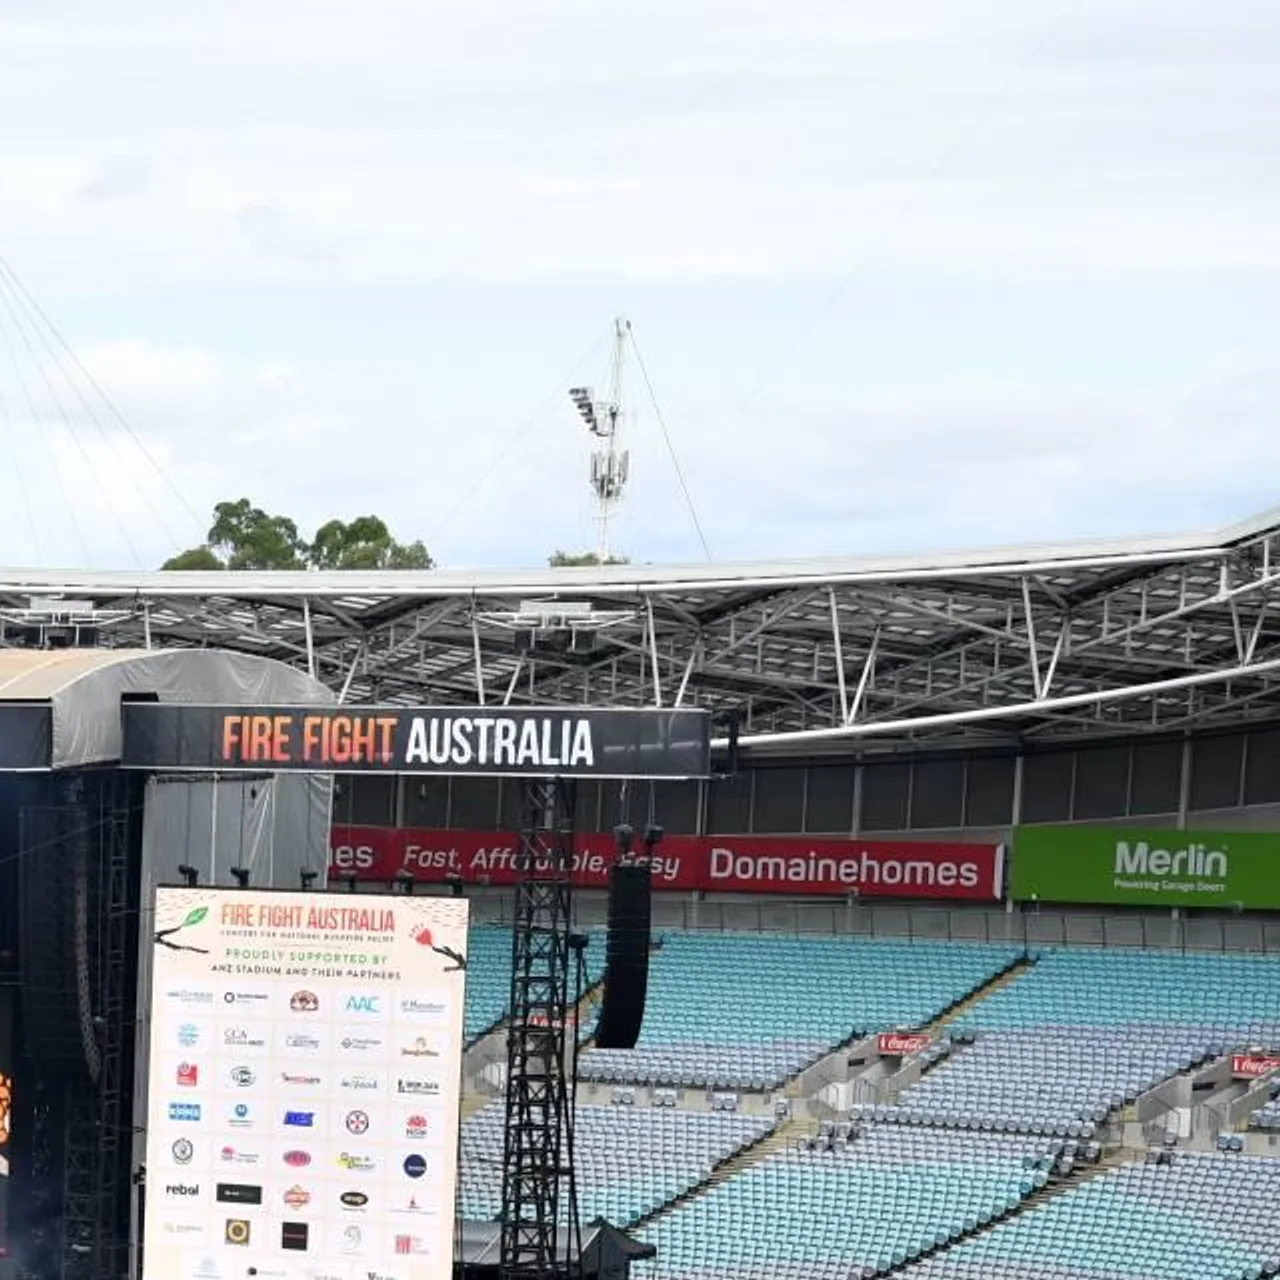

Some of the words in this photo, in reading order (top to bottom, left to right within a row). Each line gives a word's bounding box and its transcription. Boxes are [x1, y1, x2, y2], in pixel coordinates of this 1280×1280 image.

[222, 715, 292, 762] FIRE
[303, 716, 399, 765] FIGHT
[405, 717, 594, 766] AUSTRALIA
[402, 846, 462, 870] Fast,
[709, 847, 979, 887] Domainehomes
[1115, 841, 1227, 878] Merlin
[221, 904, 255, 926] FIRE
[258, 905, 304, 929] FIGHT
[307, 906, 396, 932] AUSTRALIA
[226, 948, 284, 961] PROUDLY
[289, 951, 368, 965] SUPPORTED
[211, 964, 233, 974] ANZ
[236, 965, 282, 976] STADIUM
[285, 967, 309, 977] AND
[347, 970, 402, 980] PARTNERS
